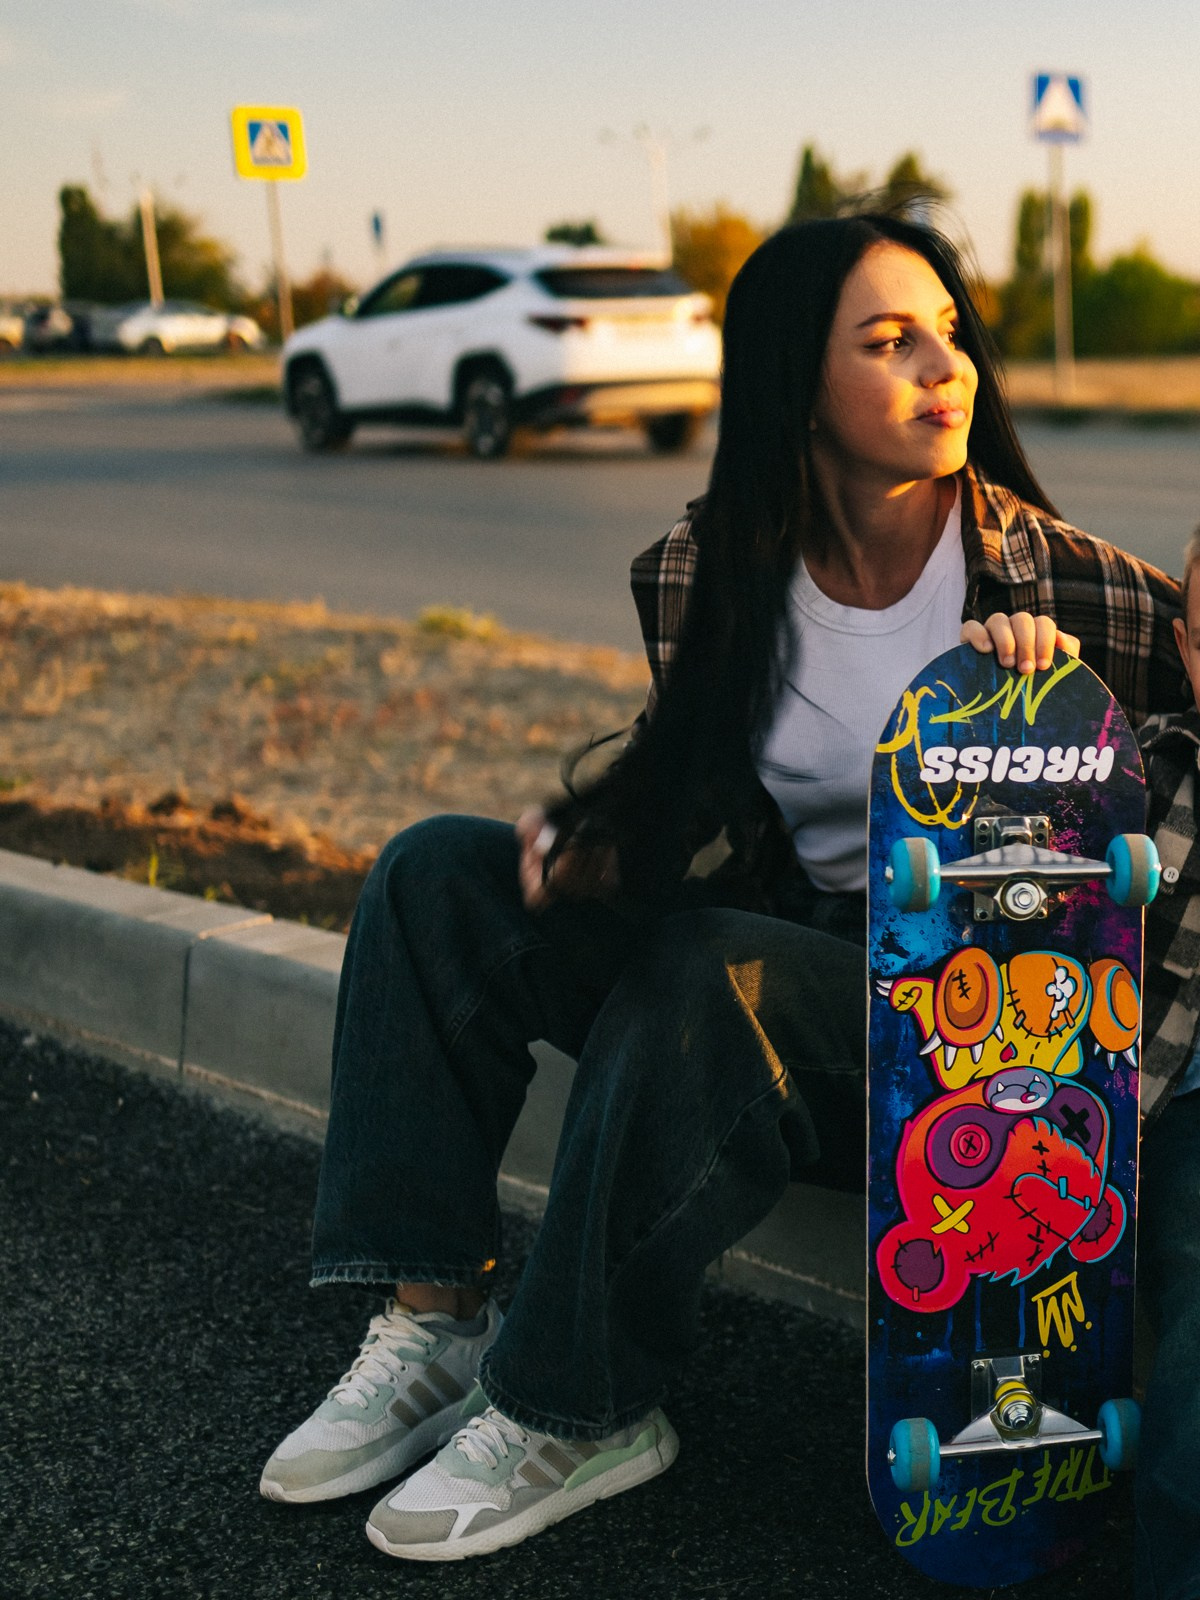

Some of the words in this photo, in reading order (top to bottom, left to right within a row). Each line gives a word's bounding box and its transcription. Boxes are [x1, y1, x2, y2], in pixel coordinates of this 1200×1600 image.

[920, 746, 1114, 783] KREISS
[1022, 1446, 1112, 1506] THE
[895, 1468, 1025, 1546] BEAR
